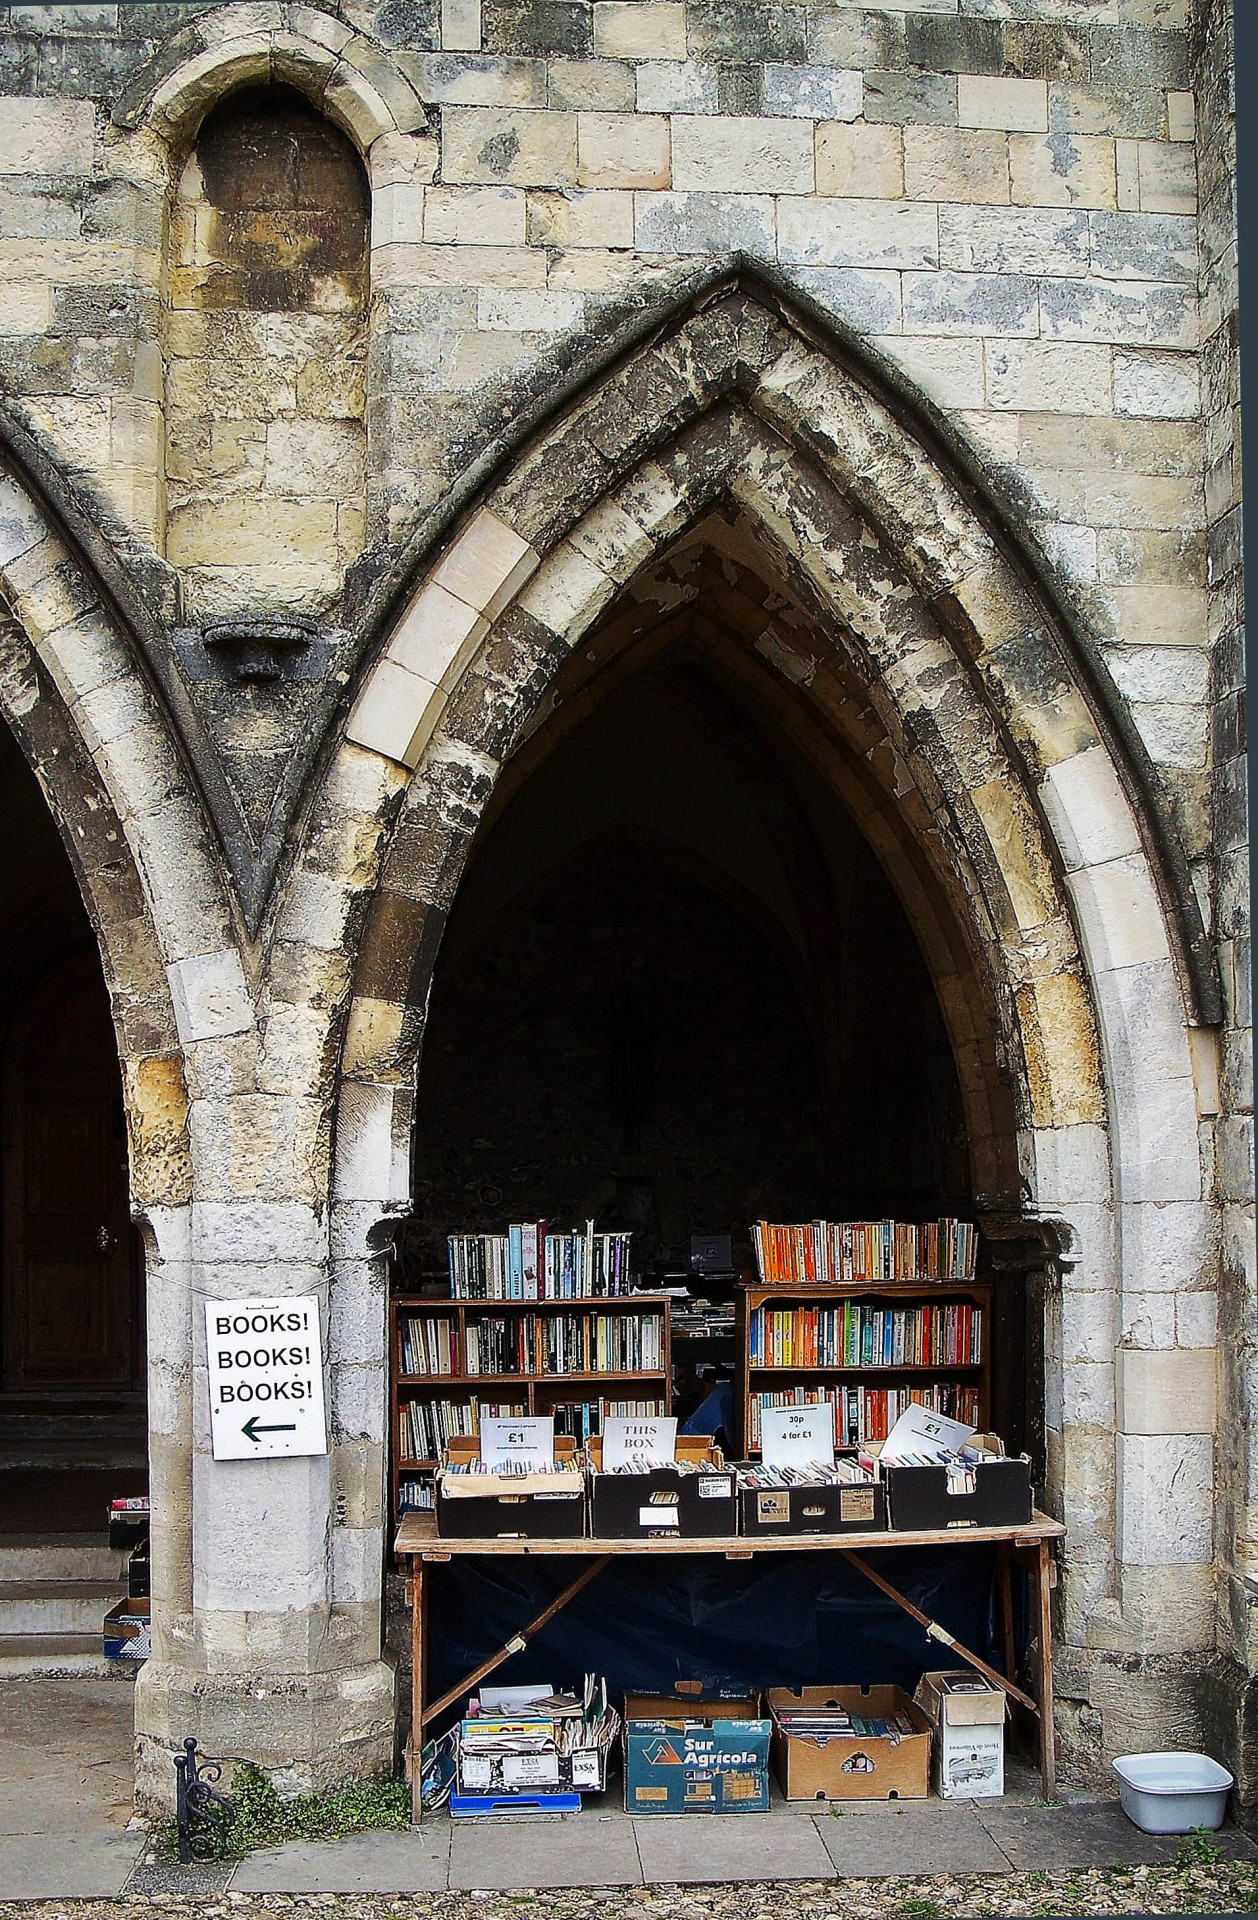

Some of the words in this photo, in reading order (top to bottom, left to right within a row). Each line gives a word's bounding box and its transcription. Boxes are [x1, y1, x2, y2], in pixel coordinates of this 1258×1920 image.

[216, 1312, 309, 1335] BOOKS!
[218, 1346, 311, 1369] BOOKS!
[220, 1380, 313, 1403] BOOKS!
[789, 1416, 805, 1424] 30p
[623, 1426, 658, 1435] THIS
[789, 1432, 801, 1440] for
[802, 1430, 812, 1438] £1
[924, 1423, 942, 1435] £1
[508, 1432, 524, 1443] £1
[624, 1438, 655, 1449] BOX
[684, 1738, 714, 1751] Sur
[684, 1750, 758, 1768] Agrícola
